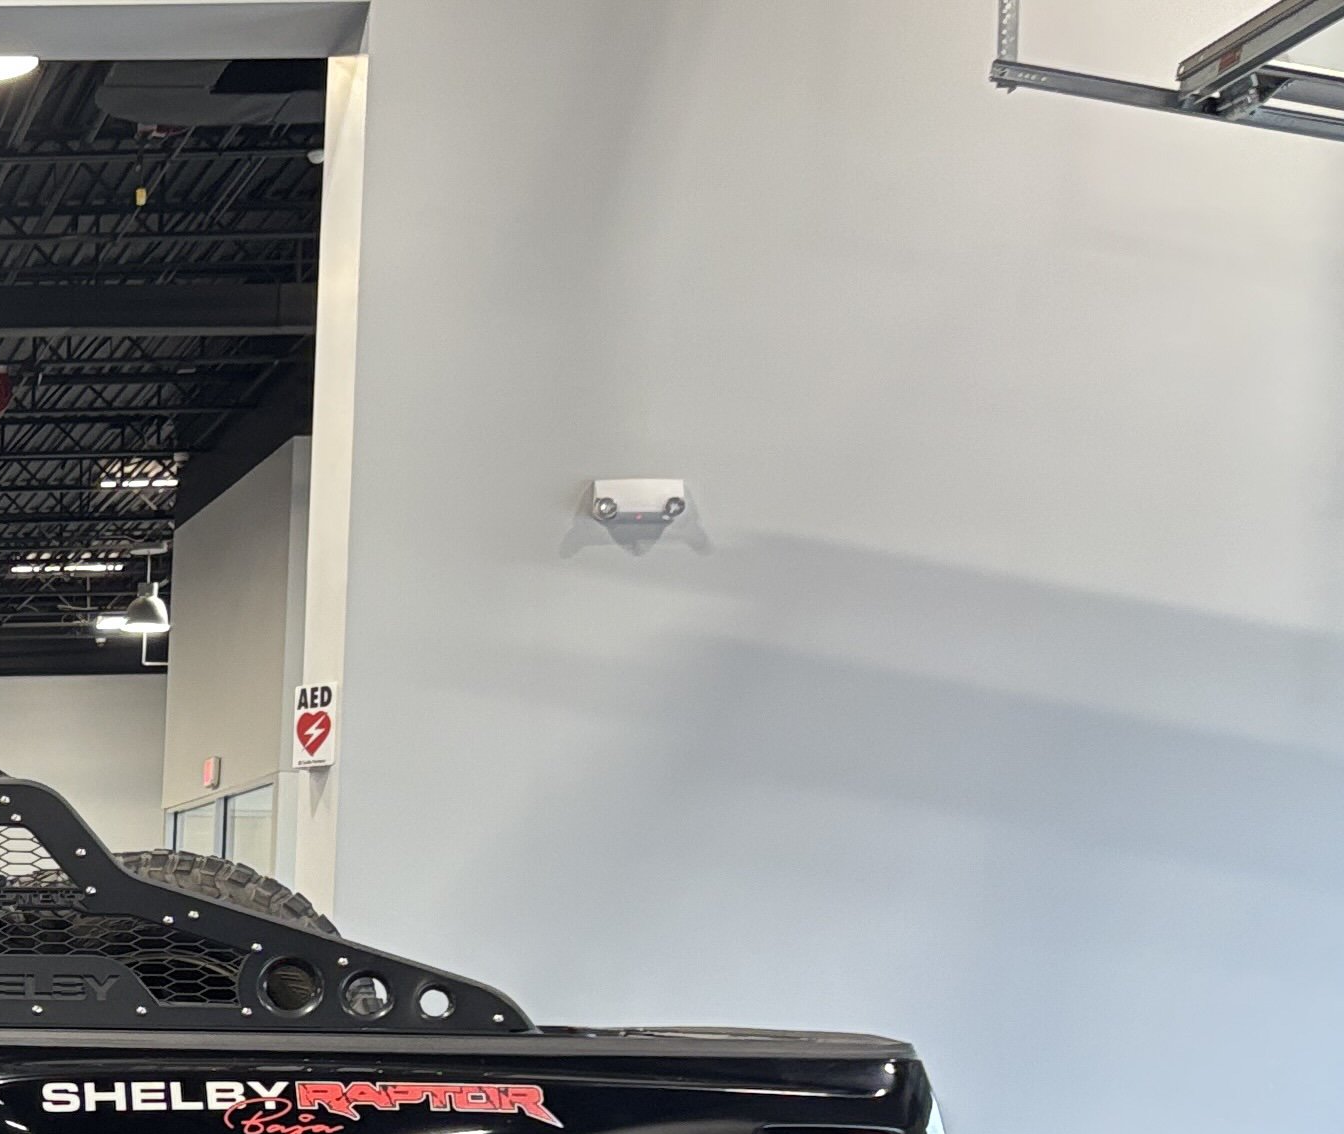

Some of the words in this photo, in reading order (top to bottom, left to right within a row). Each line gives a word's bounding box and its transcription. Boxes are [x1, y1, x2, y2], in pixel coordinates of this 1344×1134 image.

[297, 686, 332, 710] AED
[41, 1081, 289, 1113] SHELBY
[296, 1081, 564, 1129] RAPTOR
